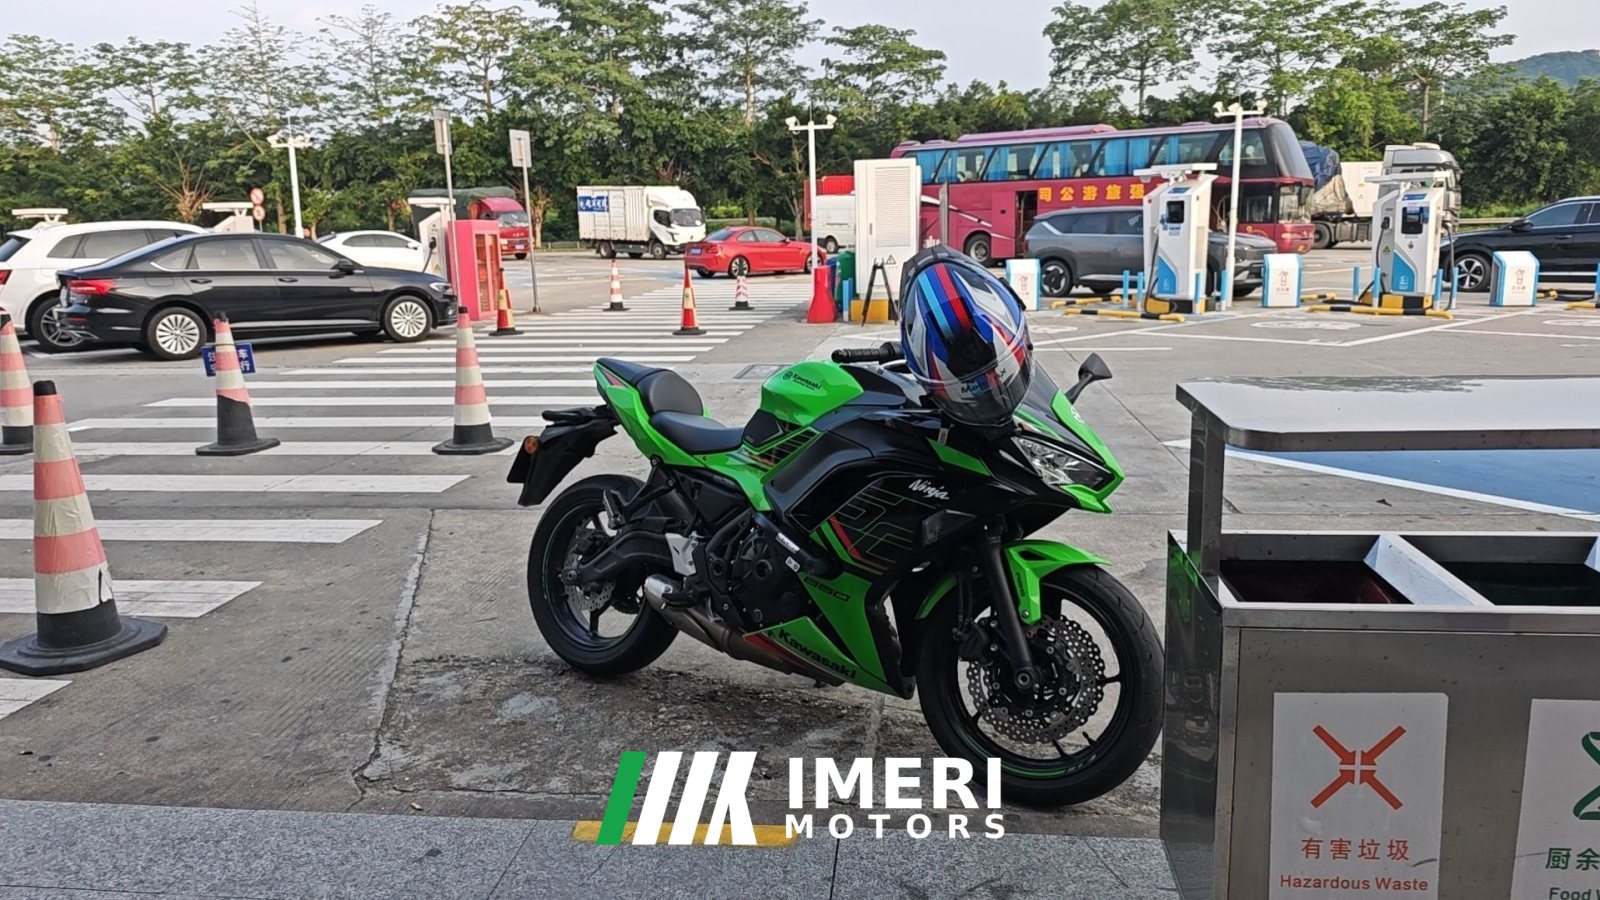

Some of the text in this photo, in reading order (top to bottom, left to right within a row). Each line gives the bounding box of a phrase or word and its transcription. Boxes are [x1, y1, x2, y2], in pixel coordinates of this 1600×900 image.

[792, 373, 822, 390] Kawasaki
[908, 479, 949, 500] Ninja
[803, 576, 851, 602] 650
[779, 628, 857, 679] Kawasaki
[1301, 837, 1409, 861] 有害垃圾
[1280, 874, 1429, 891] Hazardous Waste
[1549, 887, 1592, 900] Food
